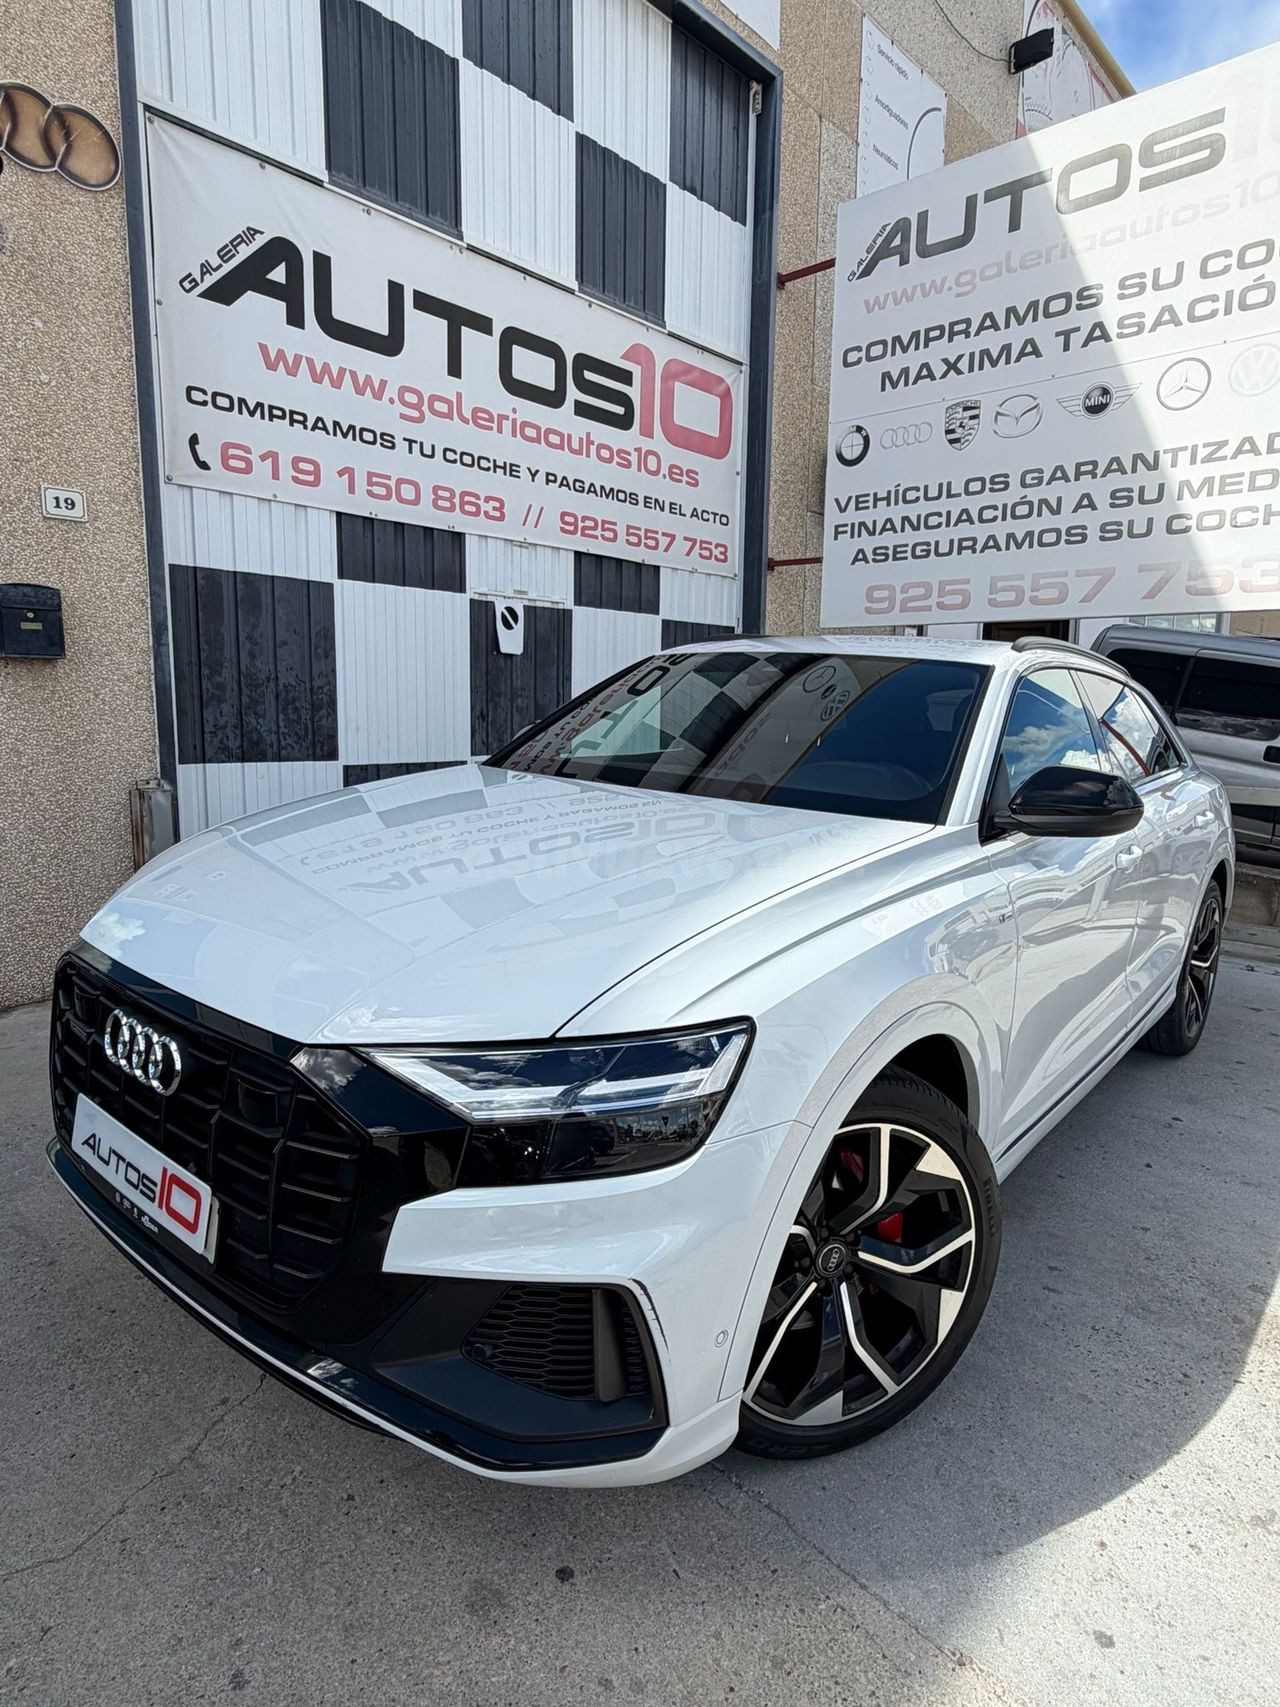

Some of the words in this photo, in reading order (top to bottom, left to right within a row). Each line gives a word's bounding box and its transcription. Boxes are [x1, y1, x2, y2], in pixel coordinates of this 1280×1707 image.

[178, 225, 266, 295] GALERIA
[847, 221, 892, 283] GALERIA
[842, 281, 1104, 368] COMPRAMOS
[1117, 261, 1185, 300] SU
[1199, 235, 1280, 280] CO
[880, 337, 1043, 392] MAXIMA
[1055, 274, 1276, 353] TASACIÓ
[196, 236, 734, 460] AUTOS10
[257, 342, 700, 489] www.galeriaautos10.es
[1084, 394, 1111, 407] MINI
[185, 385, 396, 451] COMPRAMOS
[402, 436, 436, 460] TU
[442, 446, 522, 480] COCHE
[526, 466, 542, 483] Y
[544, 472, 640, 506] PAGAMOS
[644, 494, 666, 512] EN
[668, 499, 686, 516] EL
[689, 506, 730, 527] ACTO
[834, 470, 1011, 514] VEHÍCULOS
[52, 496, 76, 511] 19
[220, 441, 322, 489] 619
[336, 466, 422, 506] 150
[431, 486, 506, 524] 863
[559, 511, 618, 543] 925
[624, 525, 677, 554] 557
[683, 535, 730, 564] 753
[833, 495, 1063, 541] FINANCIACIÓN
[1070, 492, 1098, 514] A
[1108, 482, 1166, 509] SU
[1176, 468, 1280, 501] MED
[850, 526, 1089, 566] ASEGURAMOS
[1098, 517, 1154, 542] SU
[864, 577, 971, 616] 925
[987, 566, 1116, 610] 557
[1137, 553, 1280, 600] 753
[81, 1132, 202, 1235] AUTOS10
